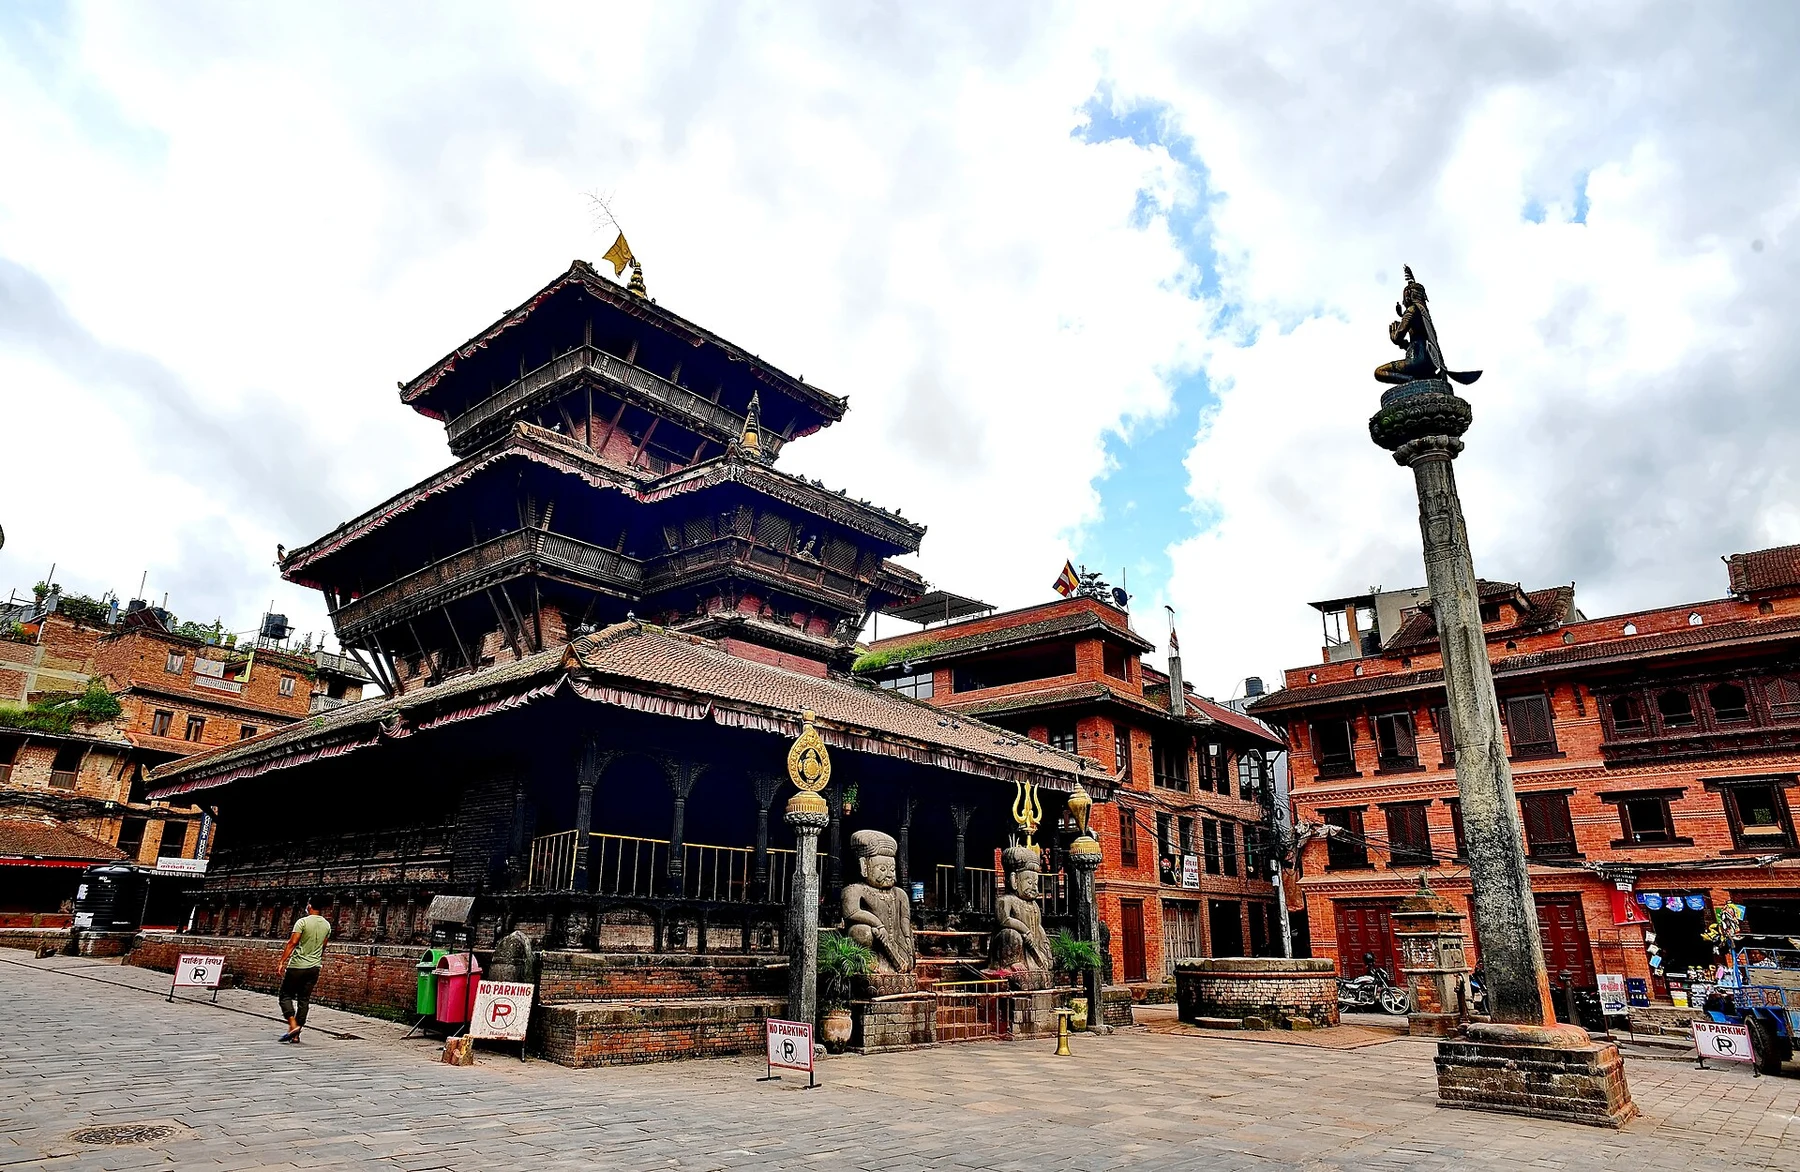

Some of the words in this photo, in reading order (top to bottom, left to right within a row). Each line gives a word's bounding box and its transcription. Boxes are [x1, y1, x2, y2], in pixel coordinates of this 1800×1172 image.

[480, 984, 491, 994] NO
[493, 984, 531, 996] PARKING
[769, 1024, 777, 1034] NO
[779, 1025, 808, 1037] PARKING
[1708, 1025, 1746, 1036] PARKING
